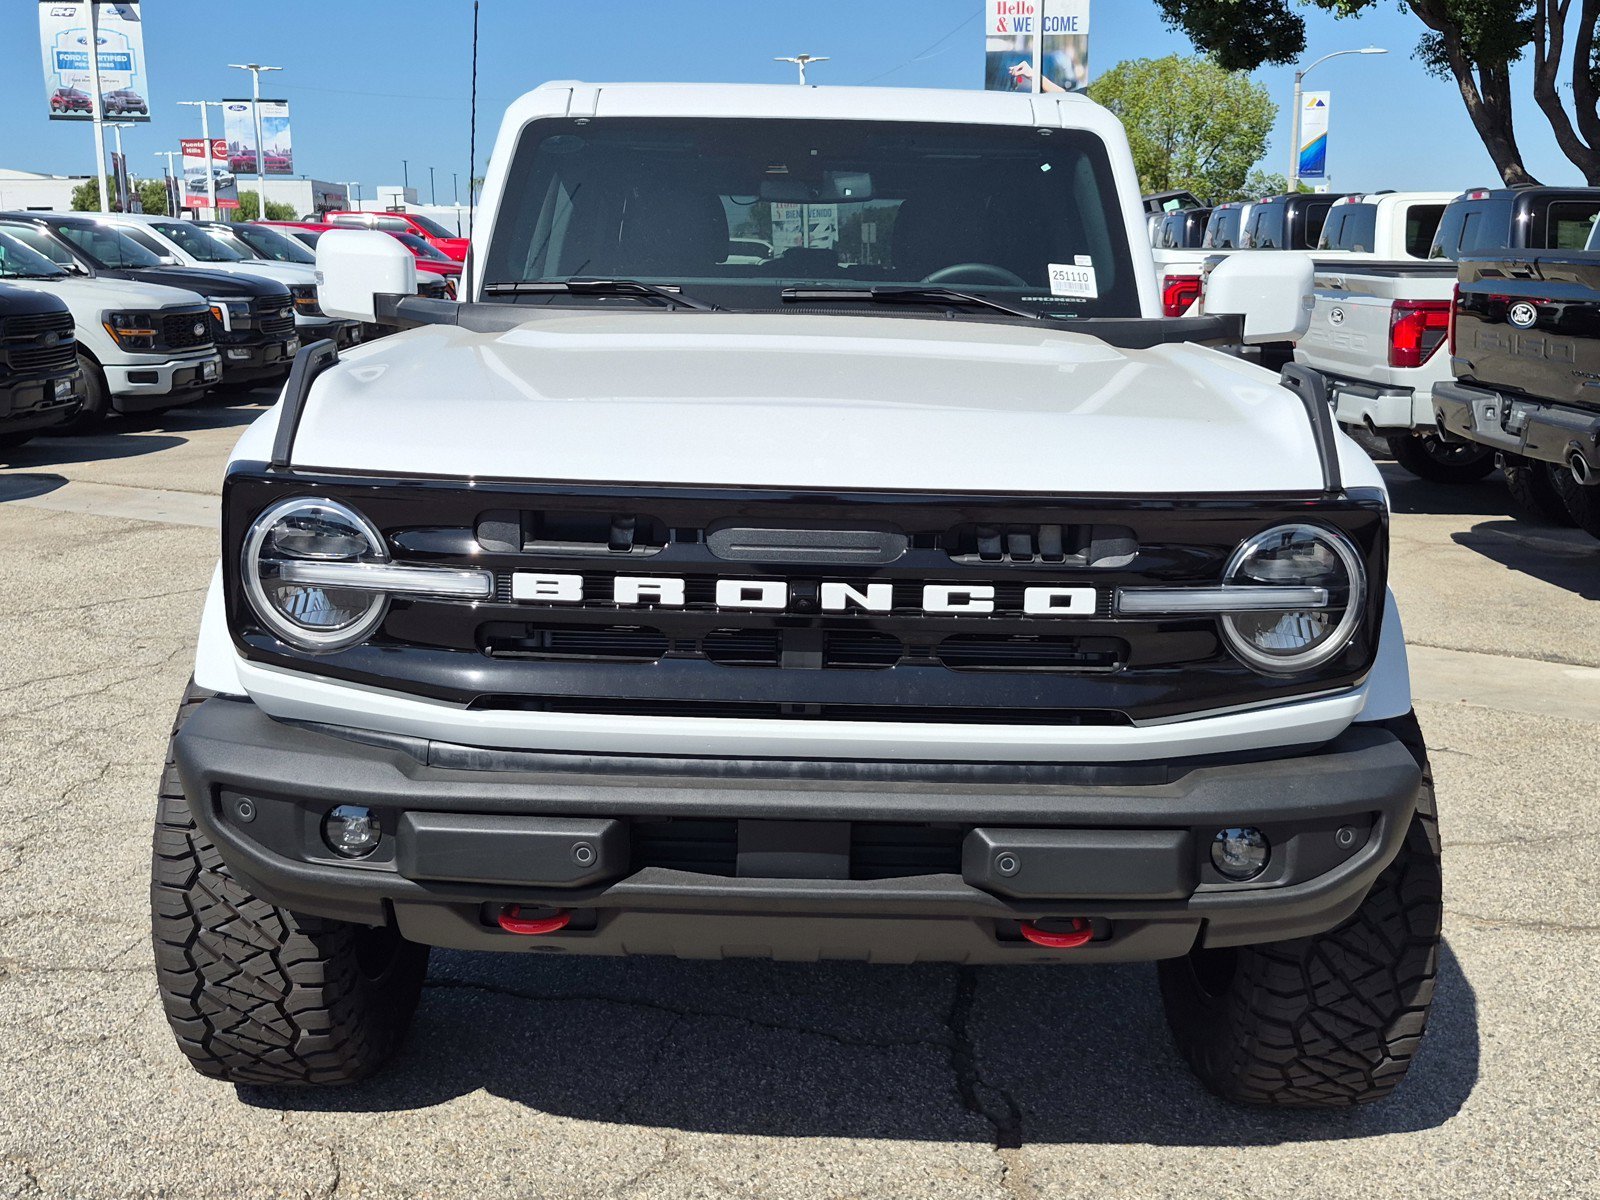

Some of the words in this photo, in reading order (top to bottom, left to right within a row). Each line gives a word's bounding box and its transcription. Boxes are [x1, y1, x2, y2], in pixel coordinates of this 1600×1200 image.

[997, 1, 1034, 14] Hello
[997, 17, 1008, 32] &
[1013, 16, 1078, 32] WECOME
[82, 54, 128, 62] CRTIFIED
[1053, 271, 1089, 282] 251110
[512, 572, 1098, 615] BRONCO
